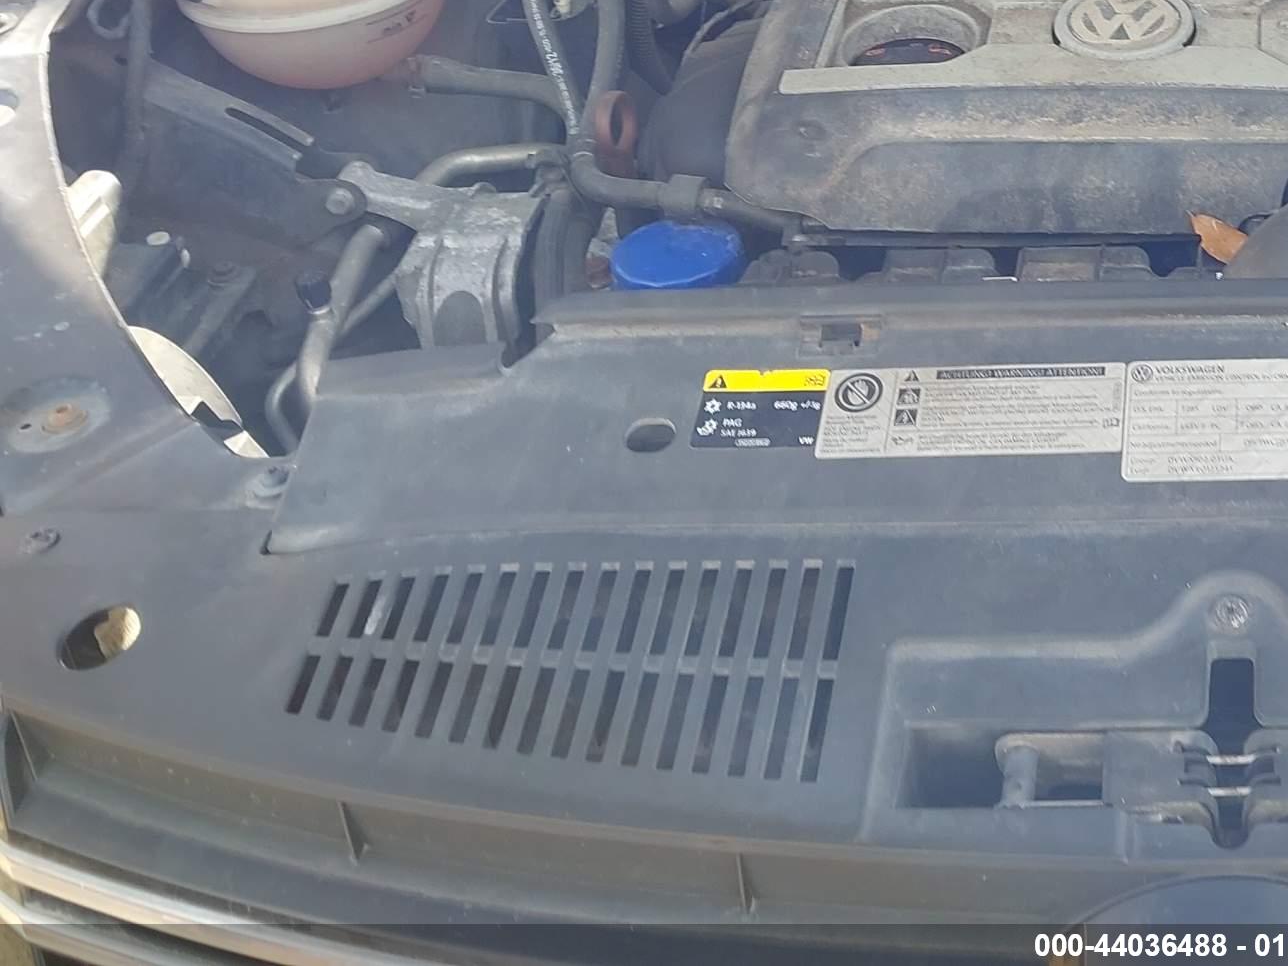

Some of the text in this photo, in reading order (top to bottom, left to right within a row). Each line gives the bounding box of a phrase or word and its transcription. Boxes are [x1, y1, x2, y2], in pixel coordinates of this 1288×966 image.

[1155, 365, 1225, 375] VOLKSWAGEN
[722, 417, 743, 428] PAG
[798, 436, 814, 445] VW
